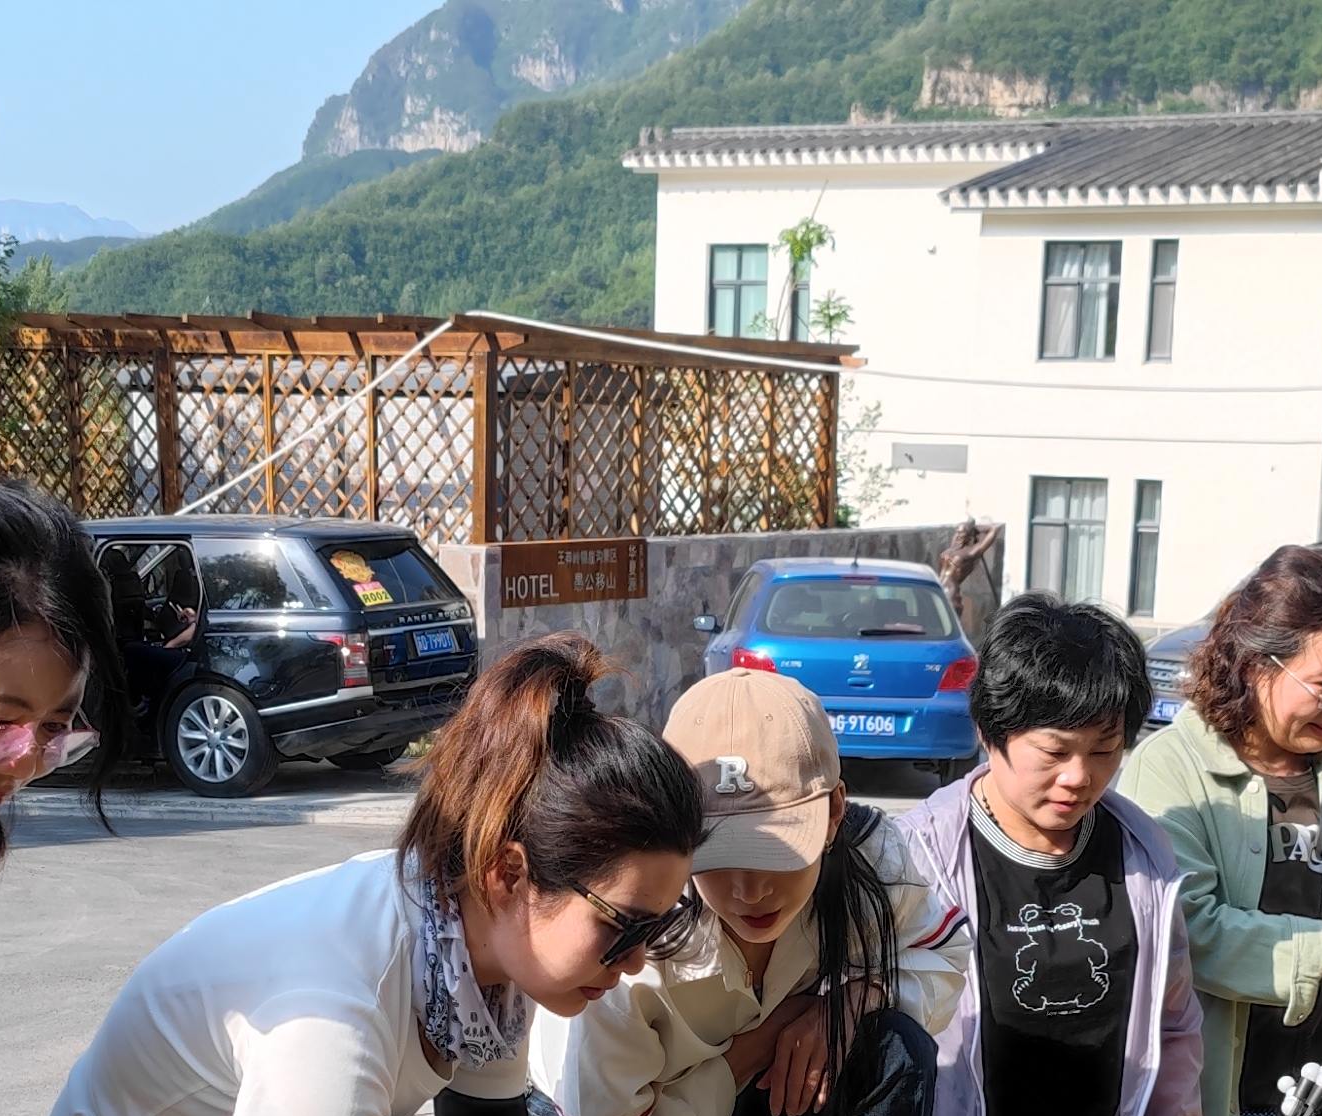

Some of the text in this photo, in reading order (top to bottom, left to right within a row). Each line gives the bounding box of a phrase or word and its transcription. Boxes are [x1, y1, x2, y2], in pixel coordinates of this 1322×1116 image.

[505, 574, 559, 600] HOTEL
[362, 591, 389, 603] R002
[398, 613, 434, 624] RANGE
[715, 755, 755, 794] R
